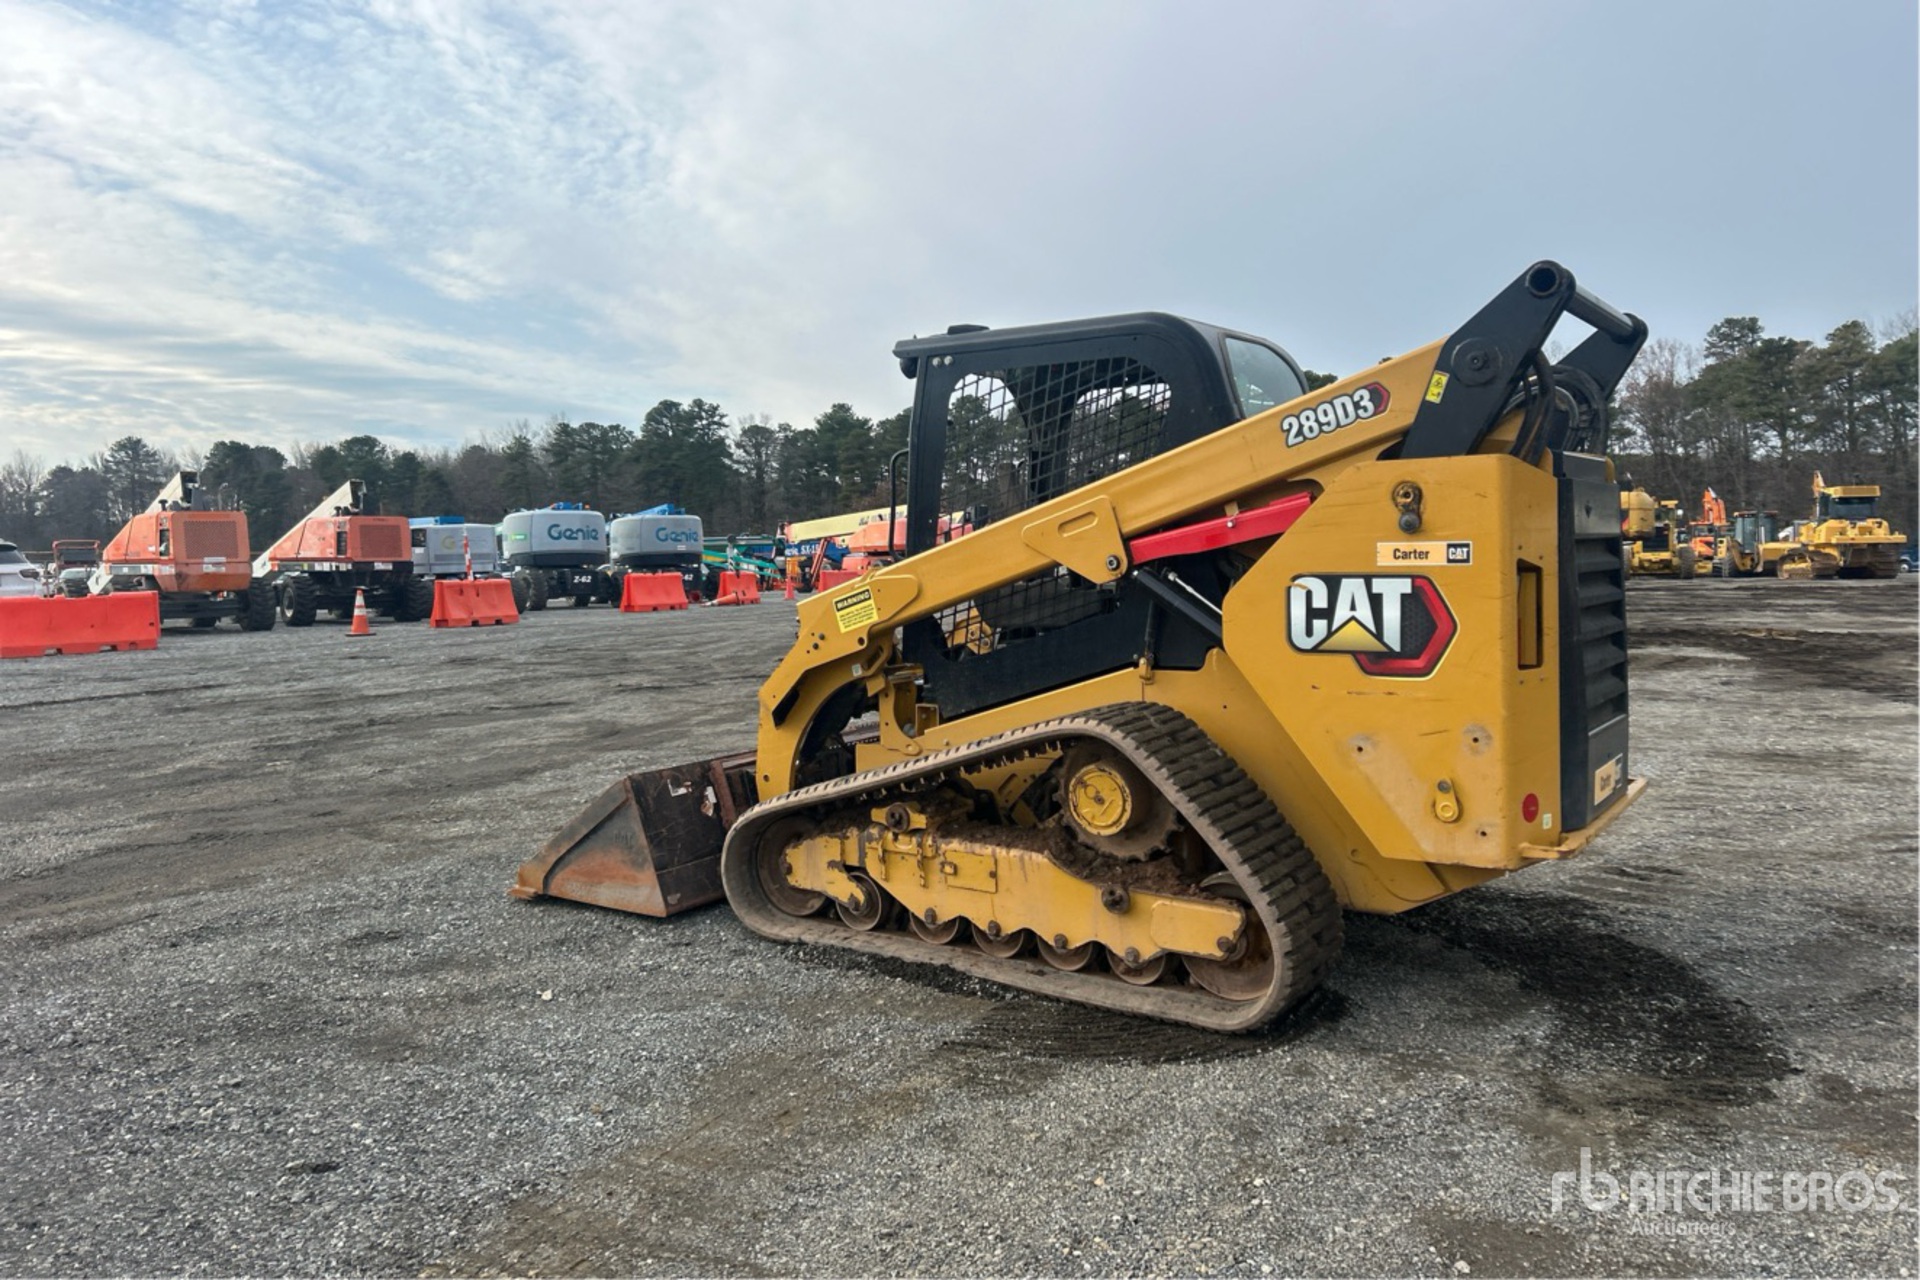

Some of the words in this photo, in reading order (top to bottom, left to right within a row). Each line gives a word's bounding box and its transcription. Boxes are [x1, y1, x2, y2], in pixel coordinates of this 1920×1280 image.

[1281, 388, 1376, 448] 289D3
[547, 523, 599, 541] Genie
[655, 527, 700, 543] Genie
[1393, 548, 1431, 560] Carter
[1448, 547, 1469, 560] CAT
[573, 576, 592, 584] Z-62
[836, 590, 870, 609] WARNING
[1289, 576, 1413, 653] CAT
